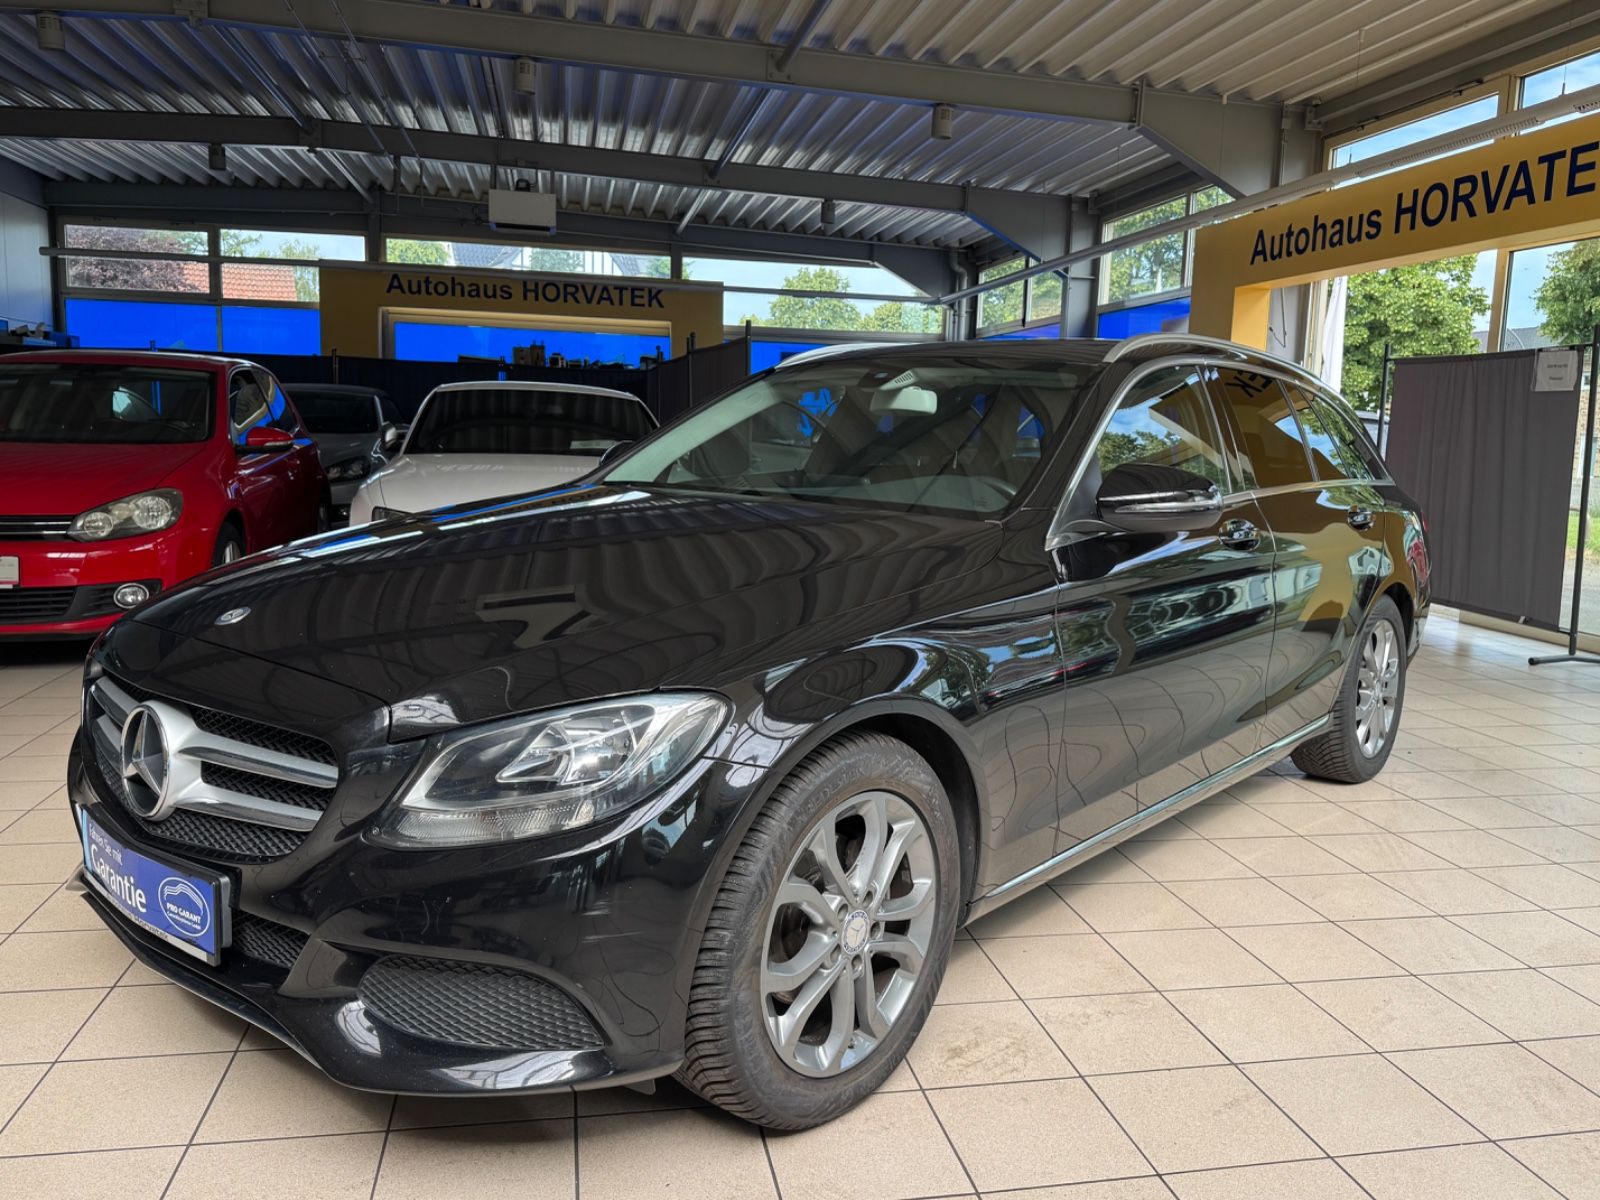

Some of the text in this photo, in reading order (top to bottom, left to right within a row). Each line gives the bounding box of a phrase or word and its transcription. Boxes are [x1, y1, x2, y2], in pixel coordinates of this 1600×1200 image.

[1249, 140, 1600, 266] Autohaus HORVATE
[385, 273, 665, 308] Autohaus HORVATEK
[112, 848, 123, 866] mit
[90, 843, 147, 913] Garantie
[166, 902, 178, 914] PRO
[178, 906, 201, 924] GARANT
